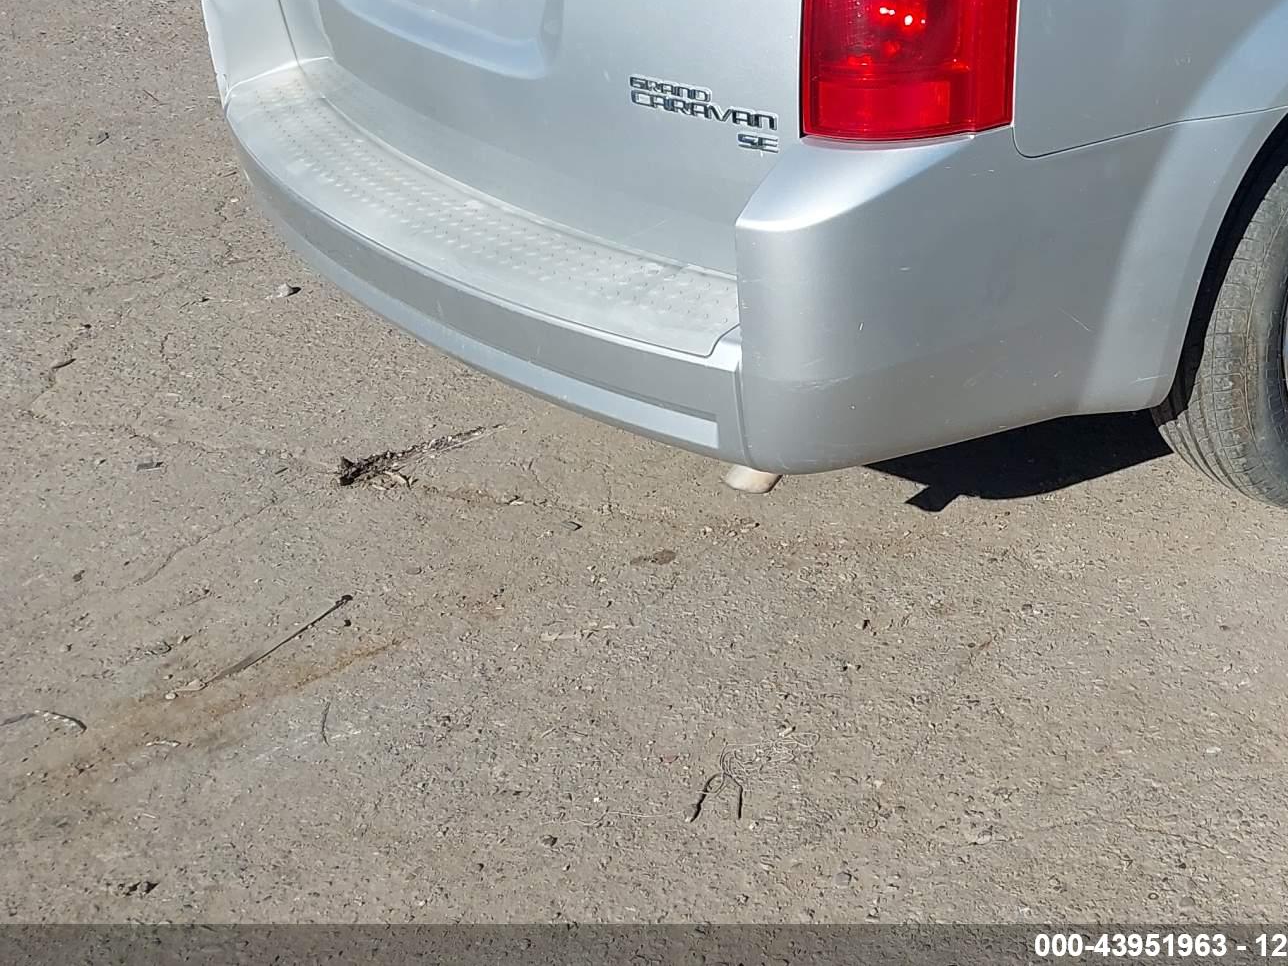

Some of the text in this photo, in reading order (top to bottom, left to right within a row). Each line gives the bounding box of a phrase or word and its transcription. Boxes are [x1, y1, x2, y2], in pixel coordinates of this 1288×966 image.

[629, 75, 712, 103] GRAND
[630, 90, 779, 131] CARAVAN
[737, 133, 779, 154] SE
